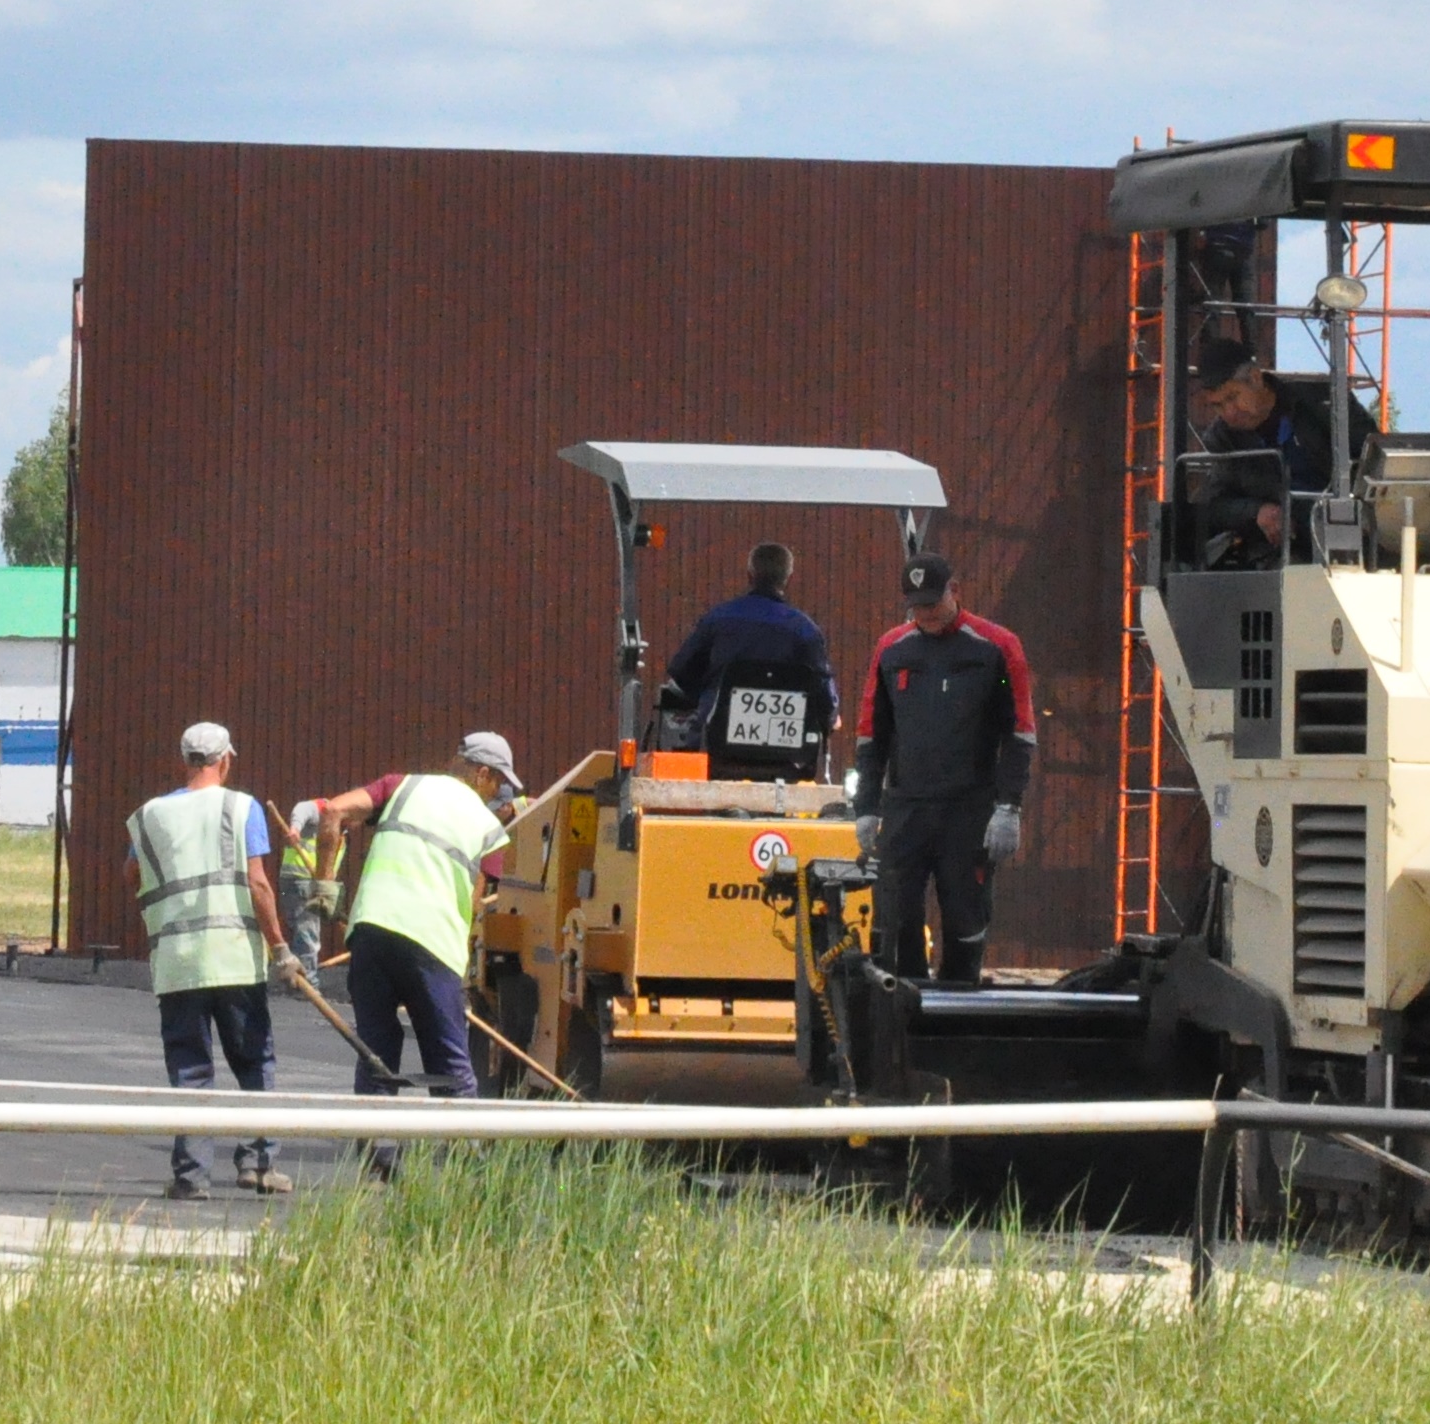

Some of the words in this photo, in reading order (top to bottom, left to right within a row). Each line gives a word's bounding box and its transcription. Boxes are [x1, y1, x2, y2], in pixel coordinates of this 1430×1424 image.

[740, 692, 796, 716] 9636
[777, 720, 797, 737] 16
[757, 841, 784, 861] 60
